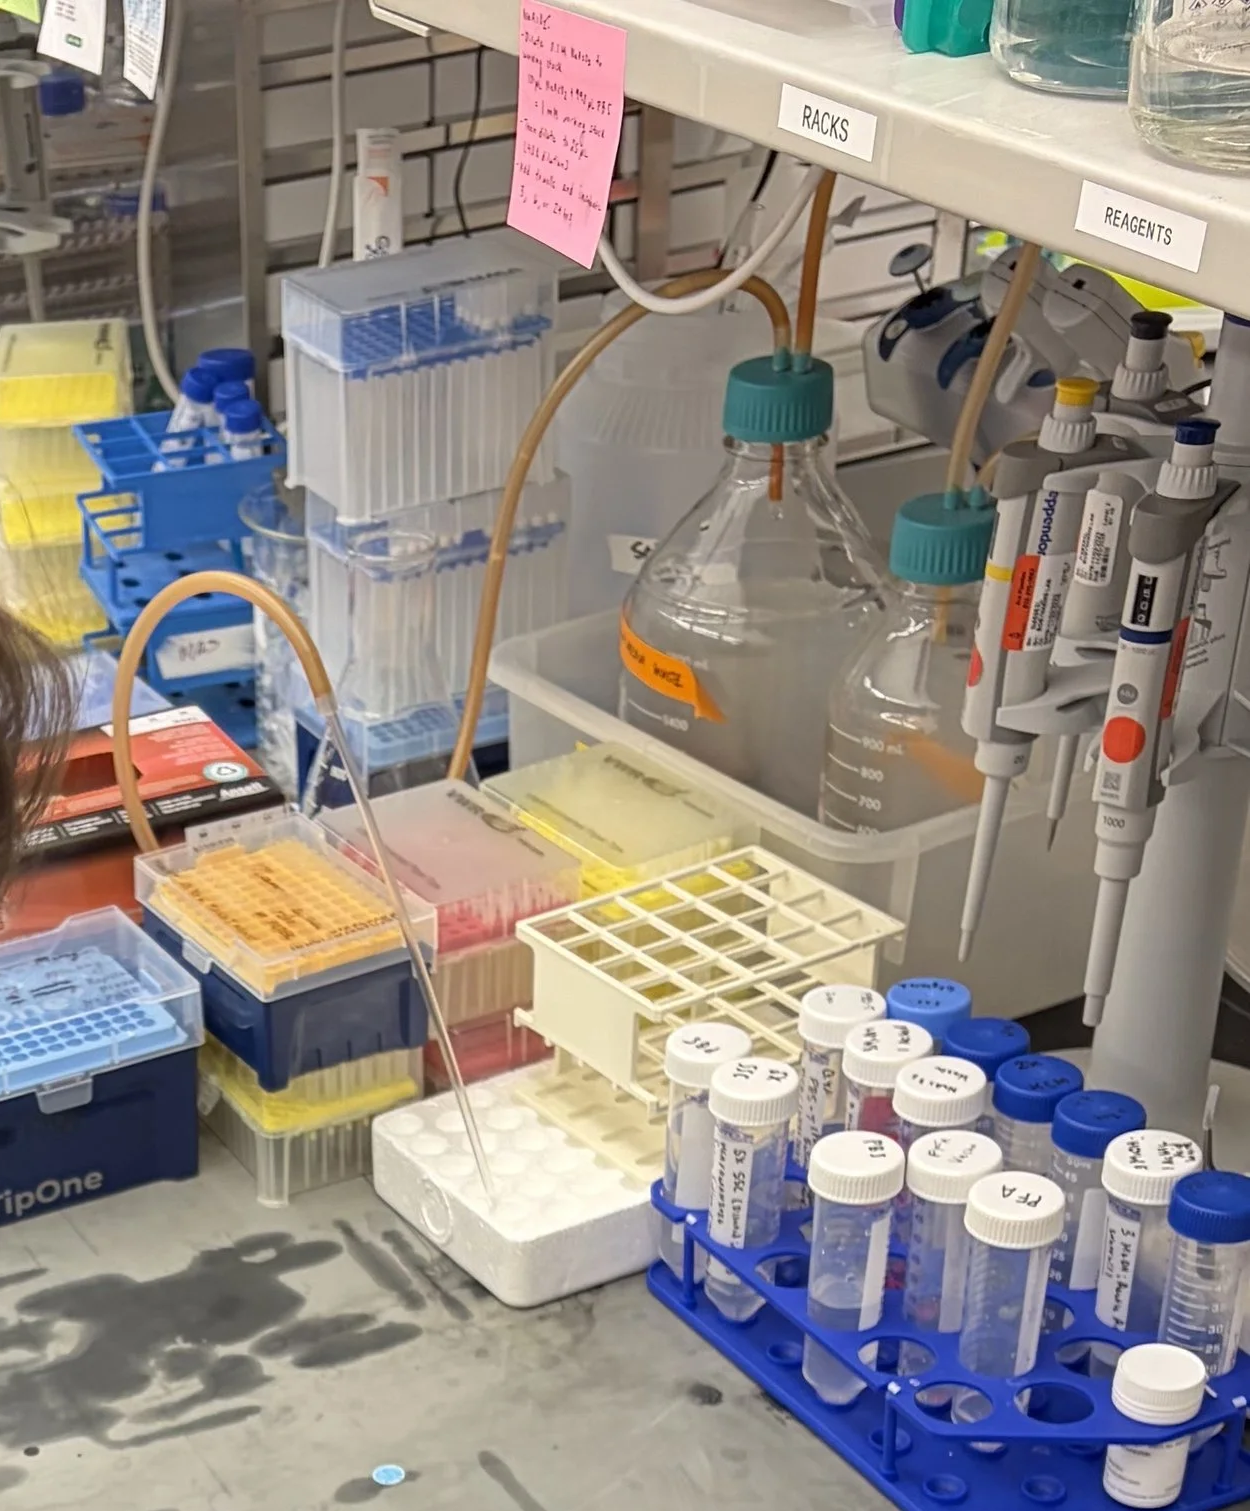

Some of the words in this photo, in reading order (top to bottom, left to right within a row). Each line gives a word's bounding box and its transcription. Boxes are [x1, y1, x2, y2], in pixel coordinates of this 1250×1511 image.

[802, 104, 850, 143] RACKS
[1104, 206, 1173, 246] REAGENTS
[861, 738, 883, 751] 900
[860, 769, 883, 782] 800
[859, 799, 880, 812] 700
[1102, 815, 1125, 829] 1000
[1000, 1184, 1043, 1208] PFA
